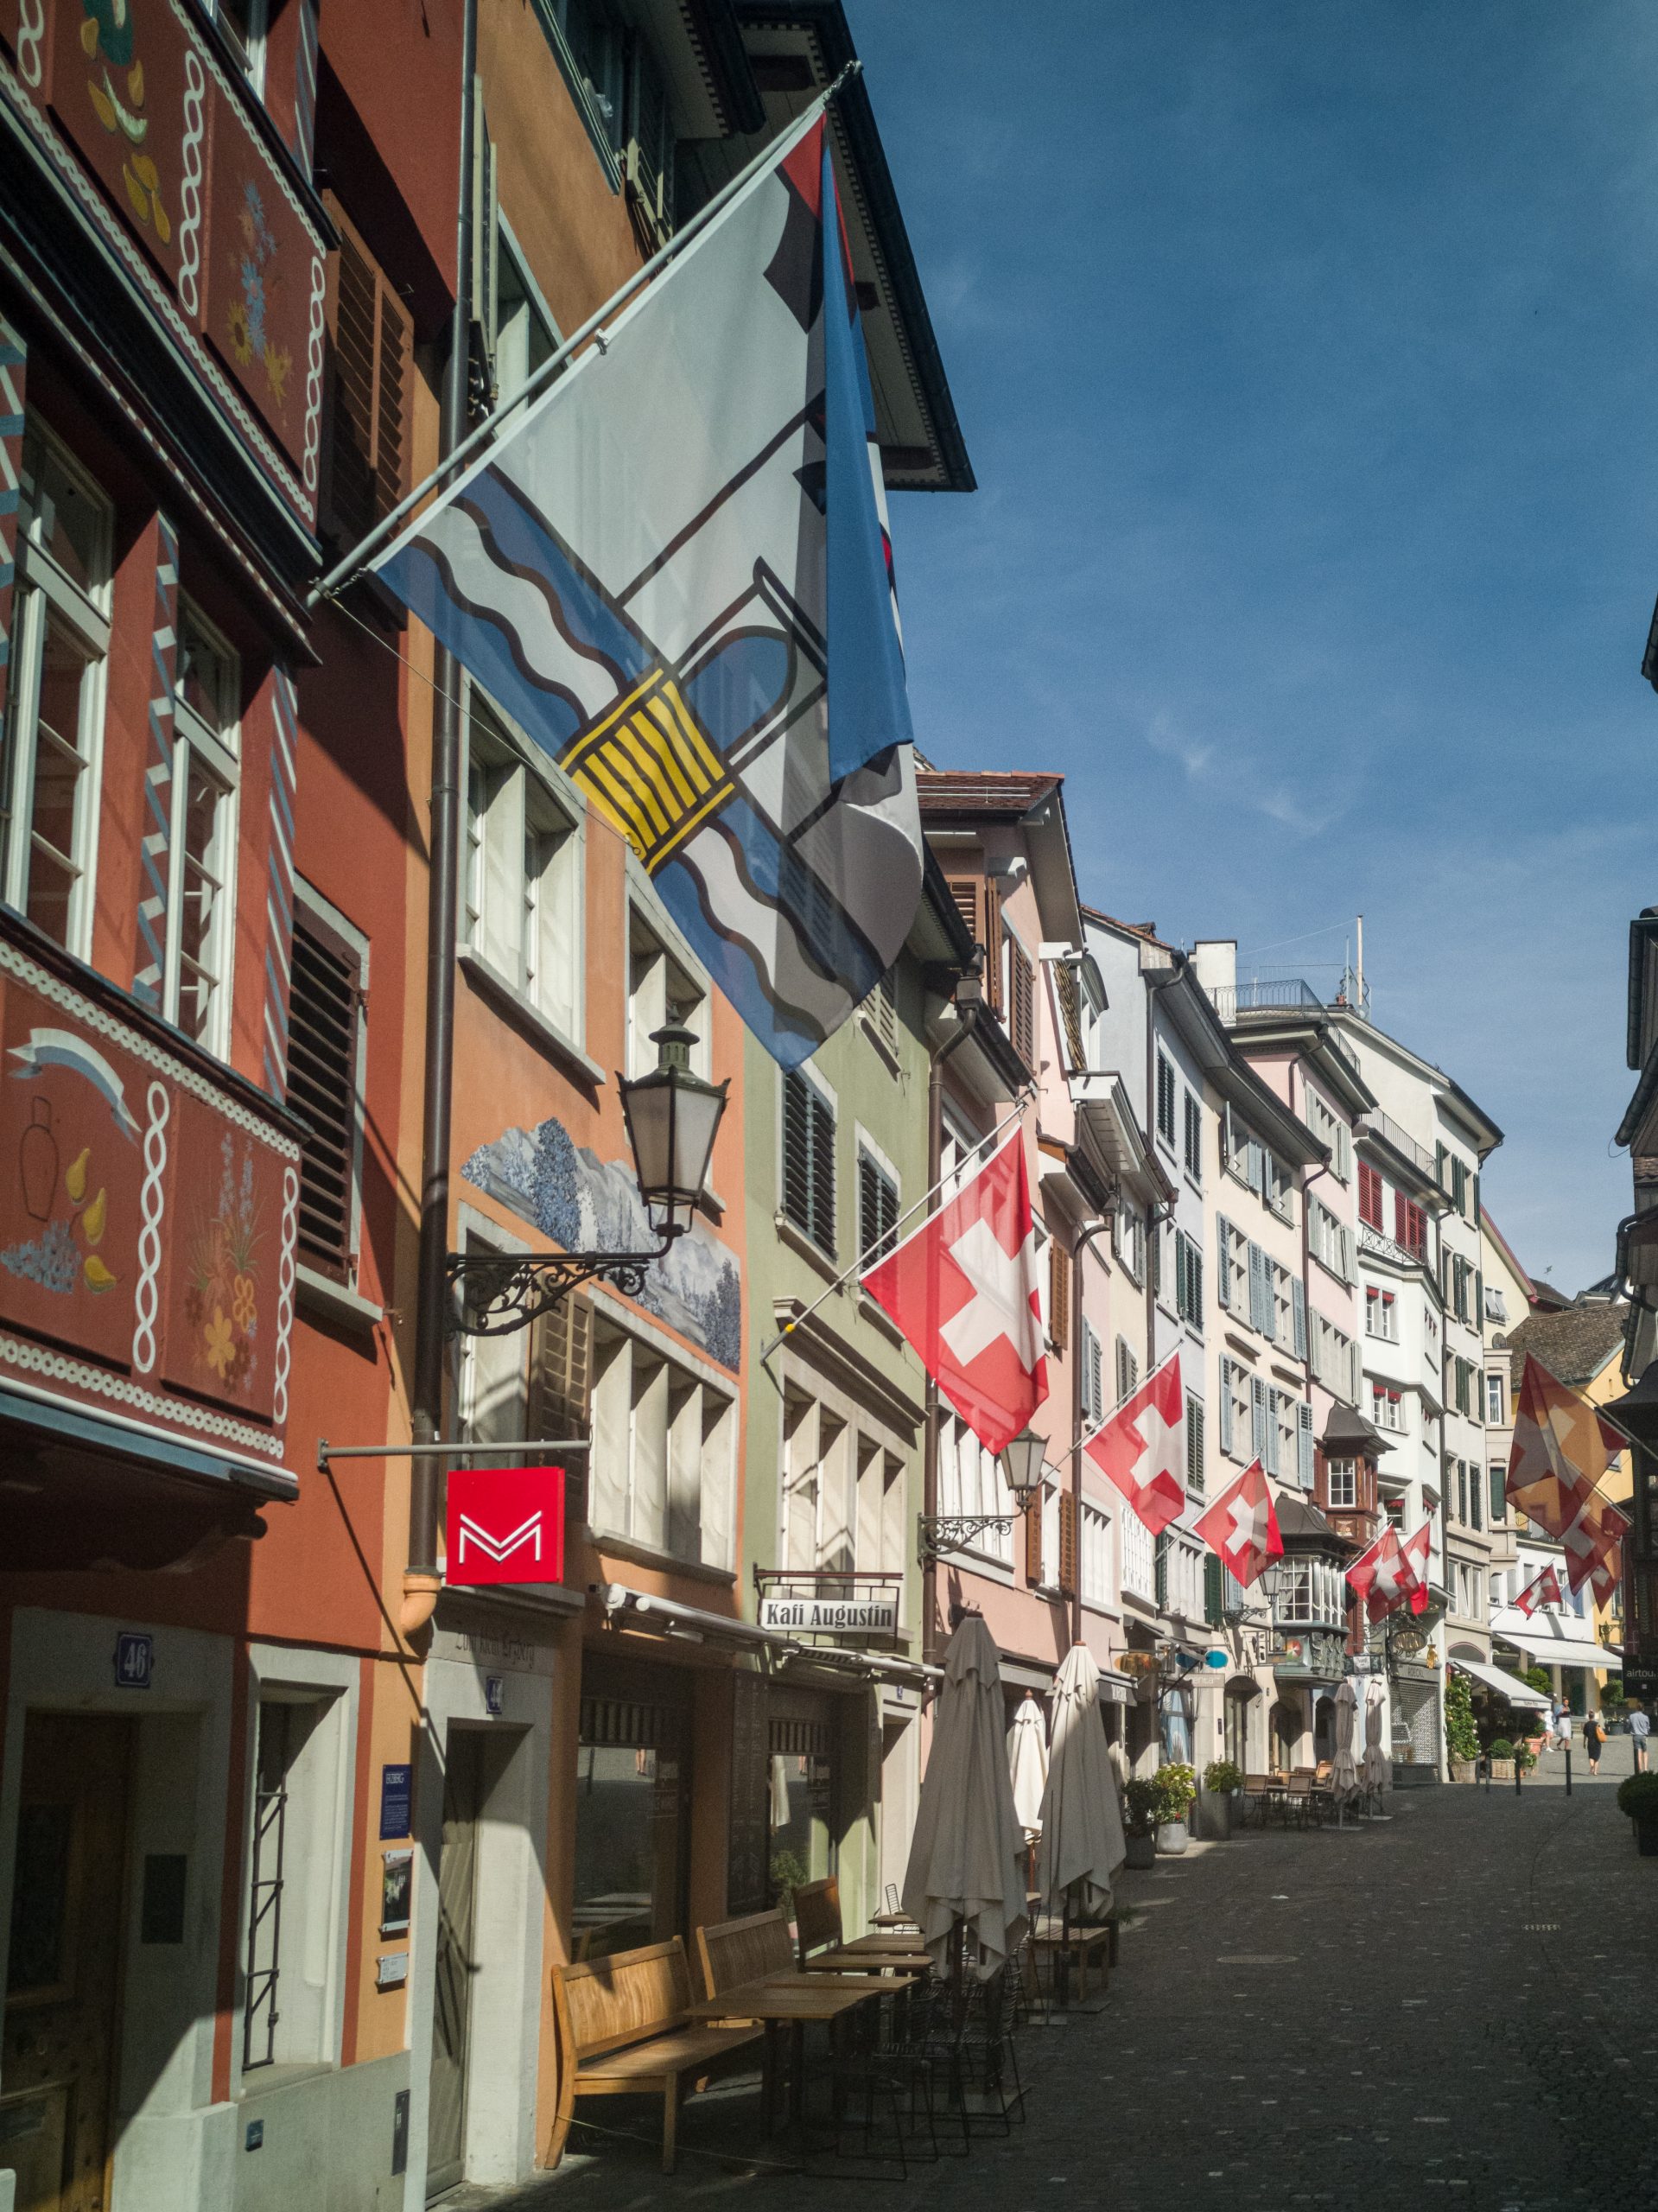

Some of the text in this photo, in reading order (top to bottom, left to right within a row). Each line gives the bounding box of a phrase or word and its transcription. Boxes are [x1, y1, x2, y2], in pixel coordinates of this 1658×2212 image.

[766, 1604, 893, 1629] Kafi Augustin
[124, 1642, 147, 1678] 46
